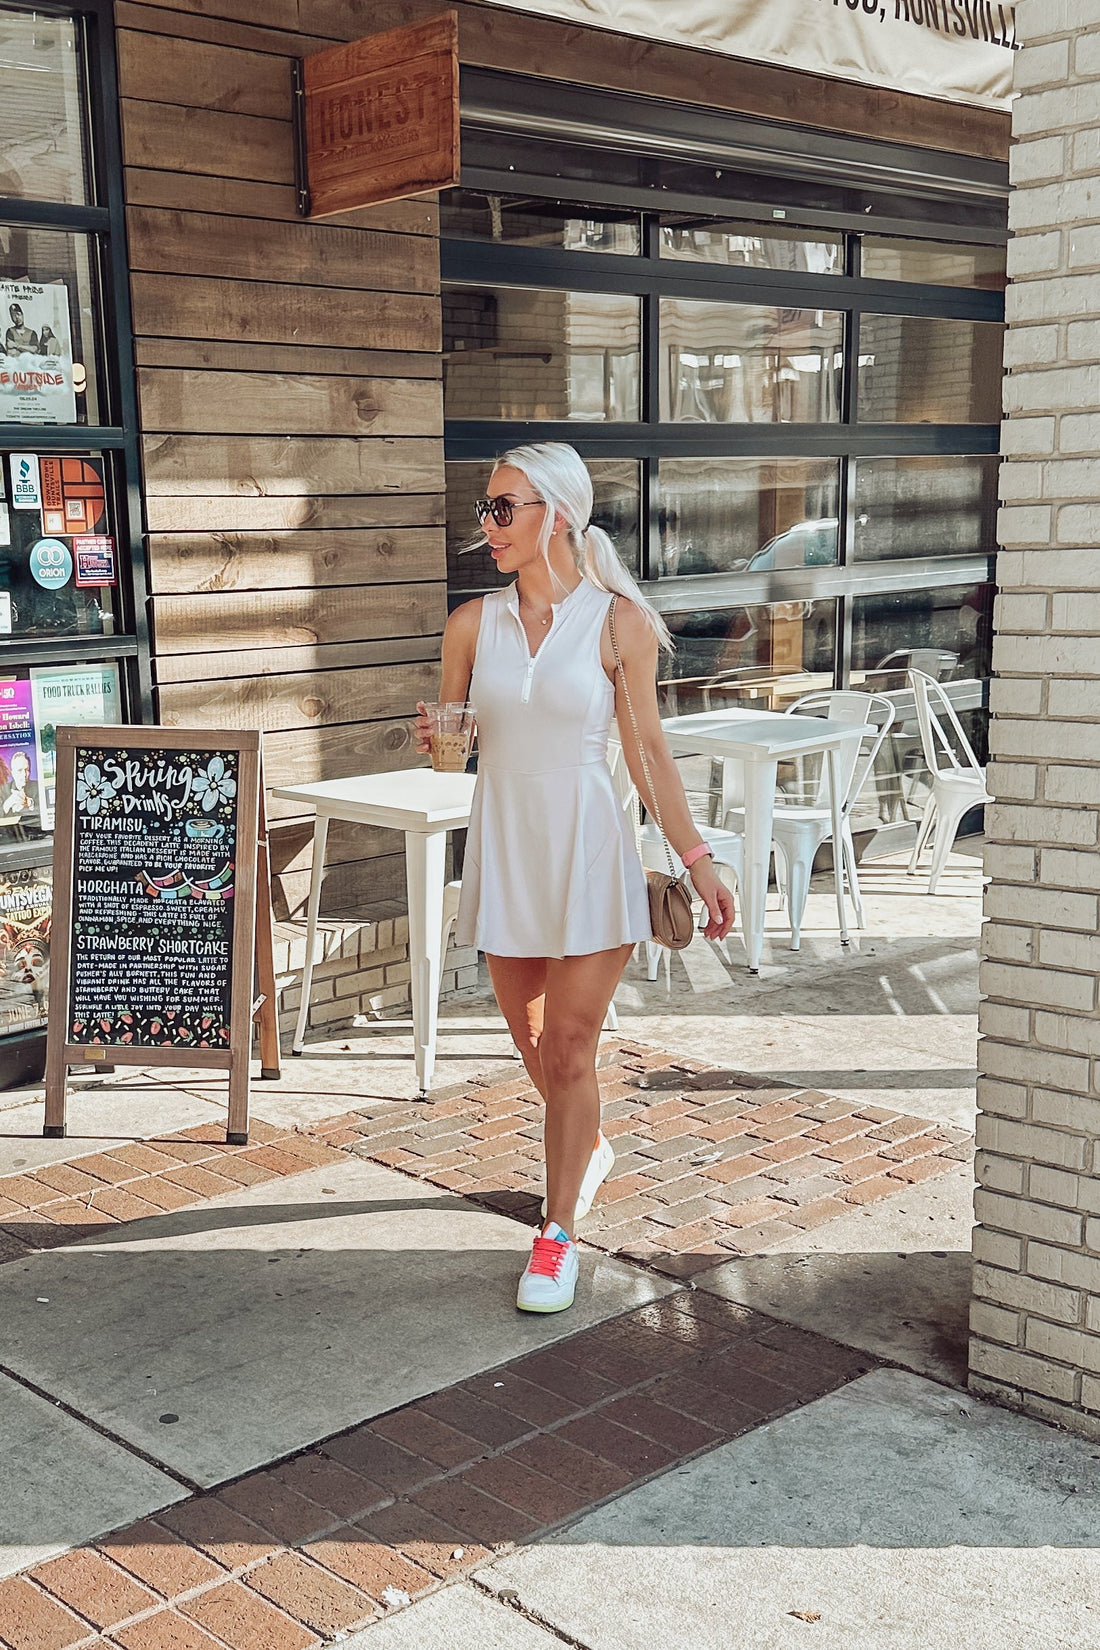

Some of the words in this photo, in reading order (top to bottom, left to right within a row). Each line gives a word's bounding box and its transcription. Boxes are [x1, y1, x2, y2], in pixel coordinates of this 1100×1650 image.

[320, 70, 429, 146] HONEST
[16, 484, 35, 493] BBB
[49, 460, 57, 507] HUNTSVILLE
[38, 567, 66, 577] ORION
[43, 685, 61, 699] FOOD
[62, 684, 85, 697] TRUCK
[86, 682, 112, 695] RALLIES
[3, 712, 30, 720] Howard
[103, 758, 192, 809] Spring
[122, 789, 173, 821] Drinks
[79, 816, 143, 832] TIRAMISU
[144, 834, 171, 842] DESSERT
[147, 847, 178, 855] DESSERT
[183, 843, 218, 851] INSPIRED
[103, 859, 142, 867] GUARANTEED
[184, 863, 216, 871] FAVORITE
[175, 856, 216, 864] CHOCOLATE
[77, 880, 144, 896] HORCHATA
[78, 895, 127, 903] TRADITIONALLY
[6, 908, 32, 922] TATTOO
[94, 909, 137, 917] REFRESHING
[208, 913, 218, 921] OF
[154, 918, 200, 927] EVERYTHING
[77, 935, 154, 953] STRAWBERRY
[158, 939, 230, 955] SHORTCAKE
[90, 953, 116, 961] RETURN
[198, 956, 218, 964] LATTE
[201, 964, 227, 972] SUGAR
[149, 978, 162, 986] ALL
[164, 978, 179, 986] THE
[181, 979, 215, 987] FLAVORS
[198, 988, 220, 996] THAT
[8, 1005, 32, 1023] JUNE
